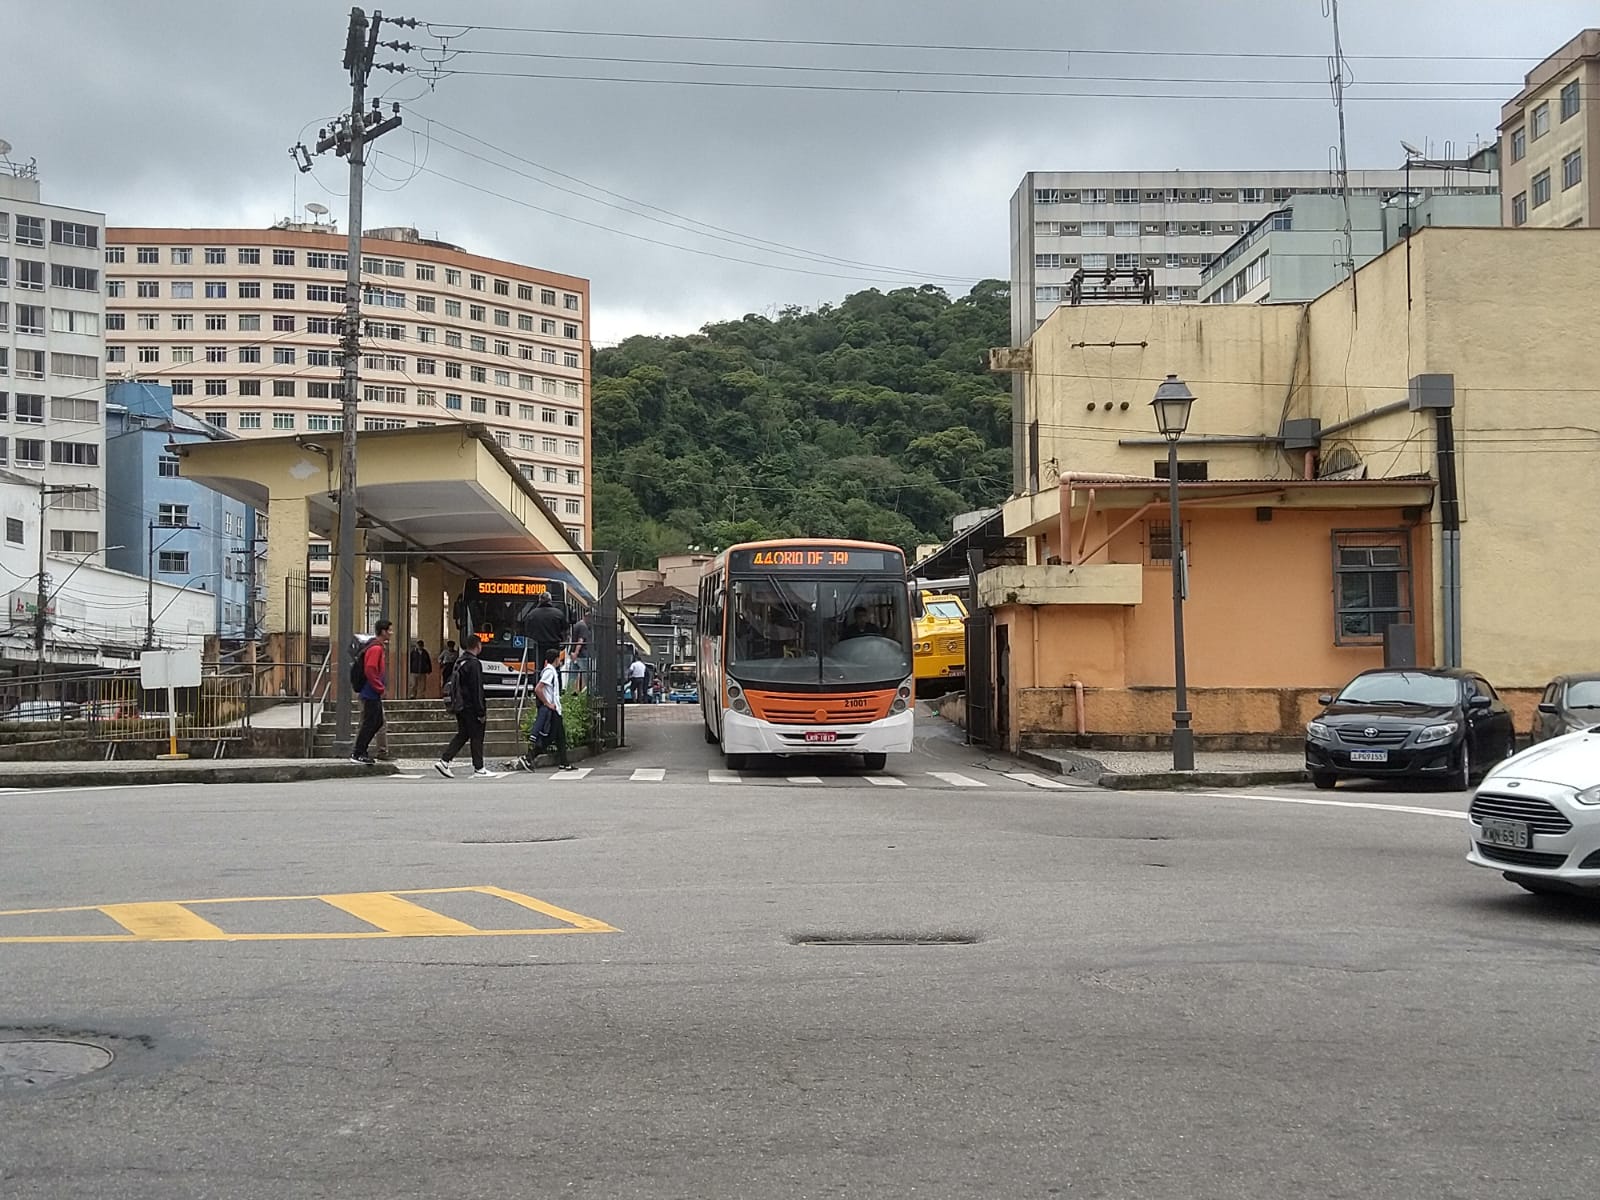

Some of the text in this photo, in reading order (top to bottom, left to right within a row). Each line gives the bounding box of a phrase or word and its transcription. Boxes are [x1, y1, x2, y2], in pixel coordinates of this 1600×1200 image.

[478, 582, 547, 595] 503 CIDADE NOVA
[844, 698, 867, 708] 21001
